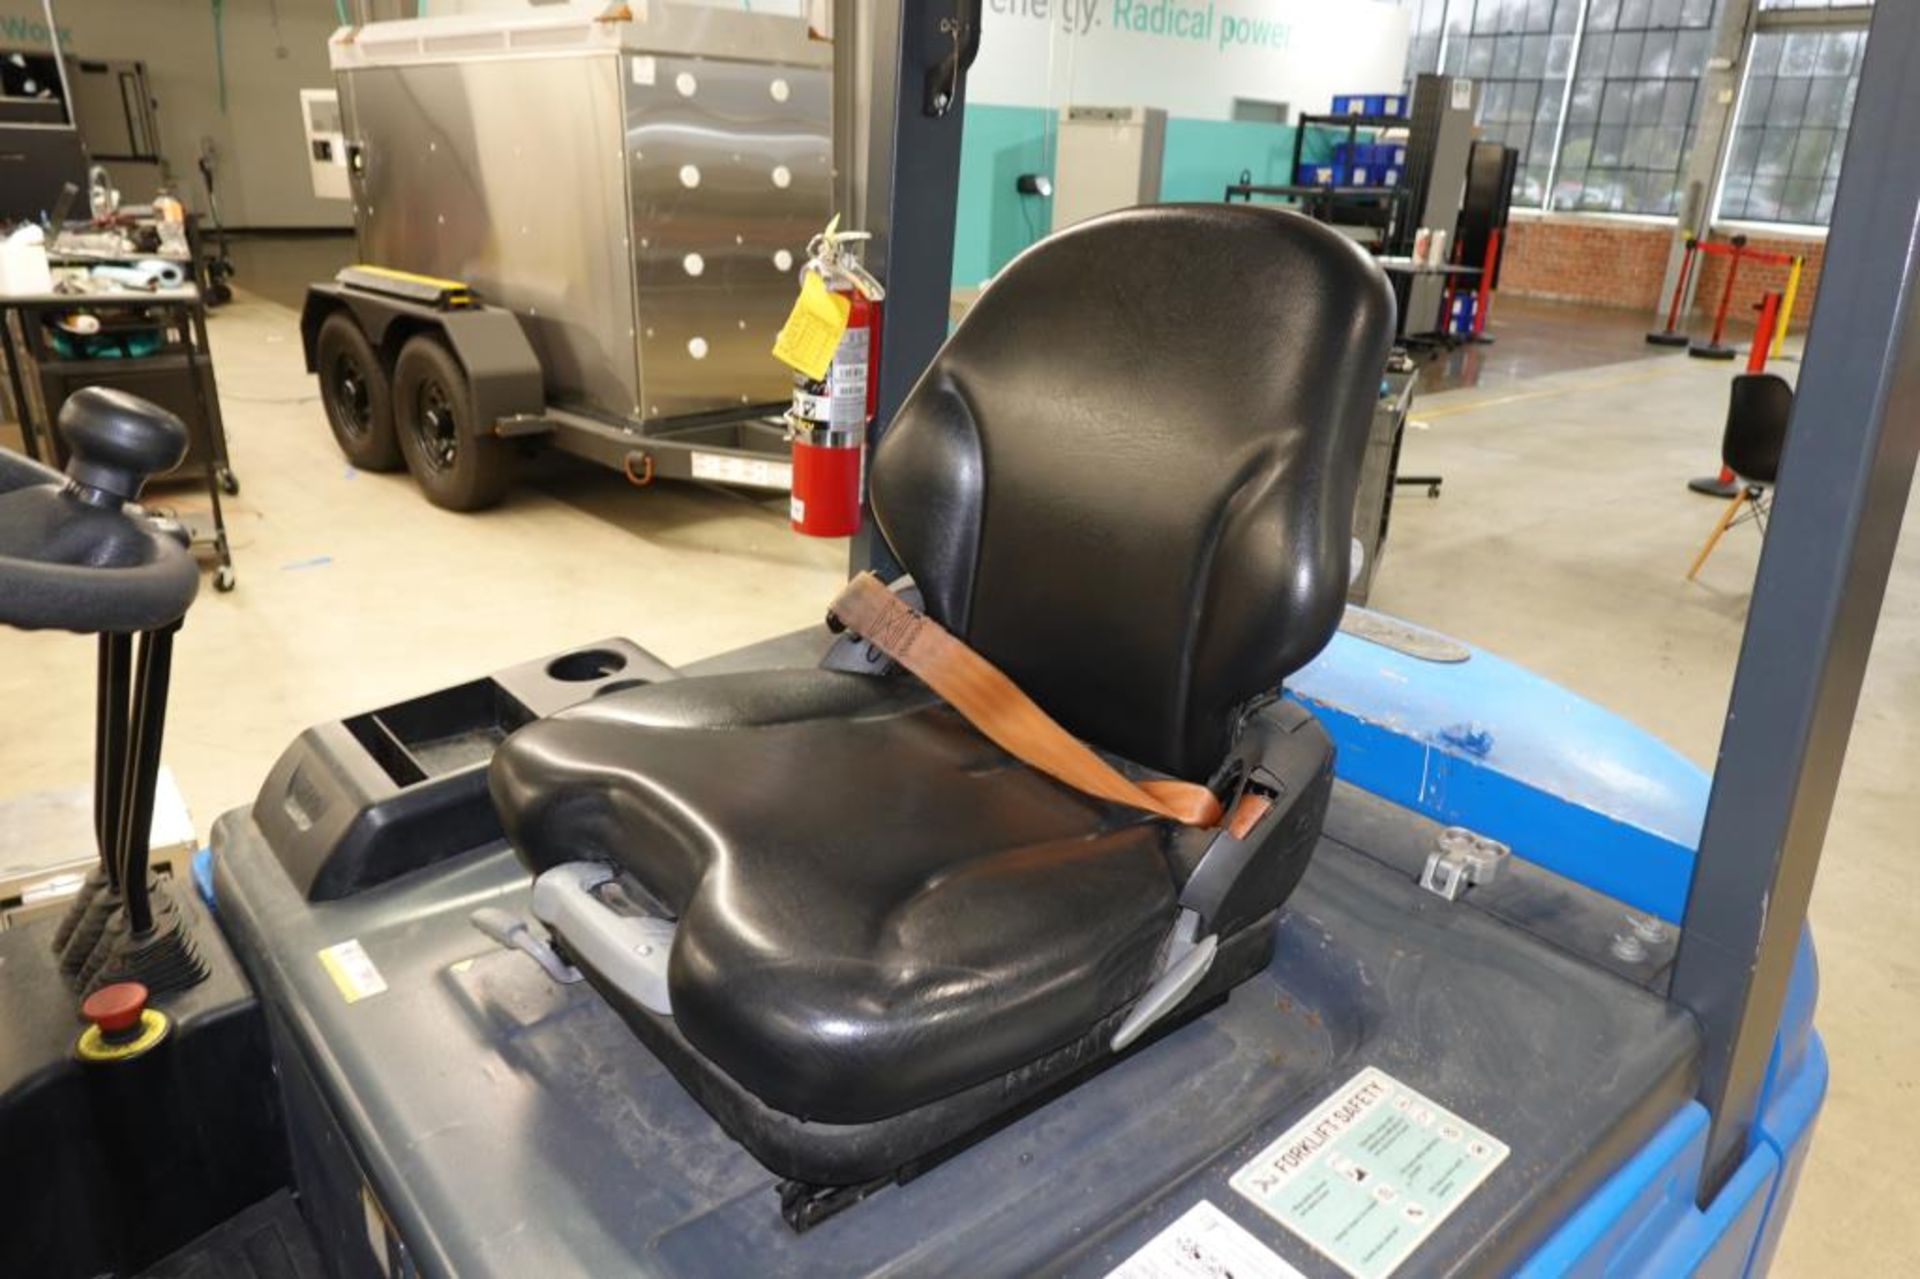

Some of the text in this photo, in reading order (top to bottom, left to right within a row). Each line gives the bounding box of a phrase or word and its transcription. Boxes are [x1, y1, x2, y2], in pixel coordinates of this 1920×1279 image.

[1111, 0, 1213, 40] Radical
[1274, 1118, 1339, 1174] FORKLIFT
[1333, 1081, 1385, 1123] SAFETY
